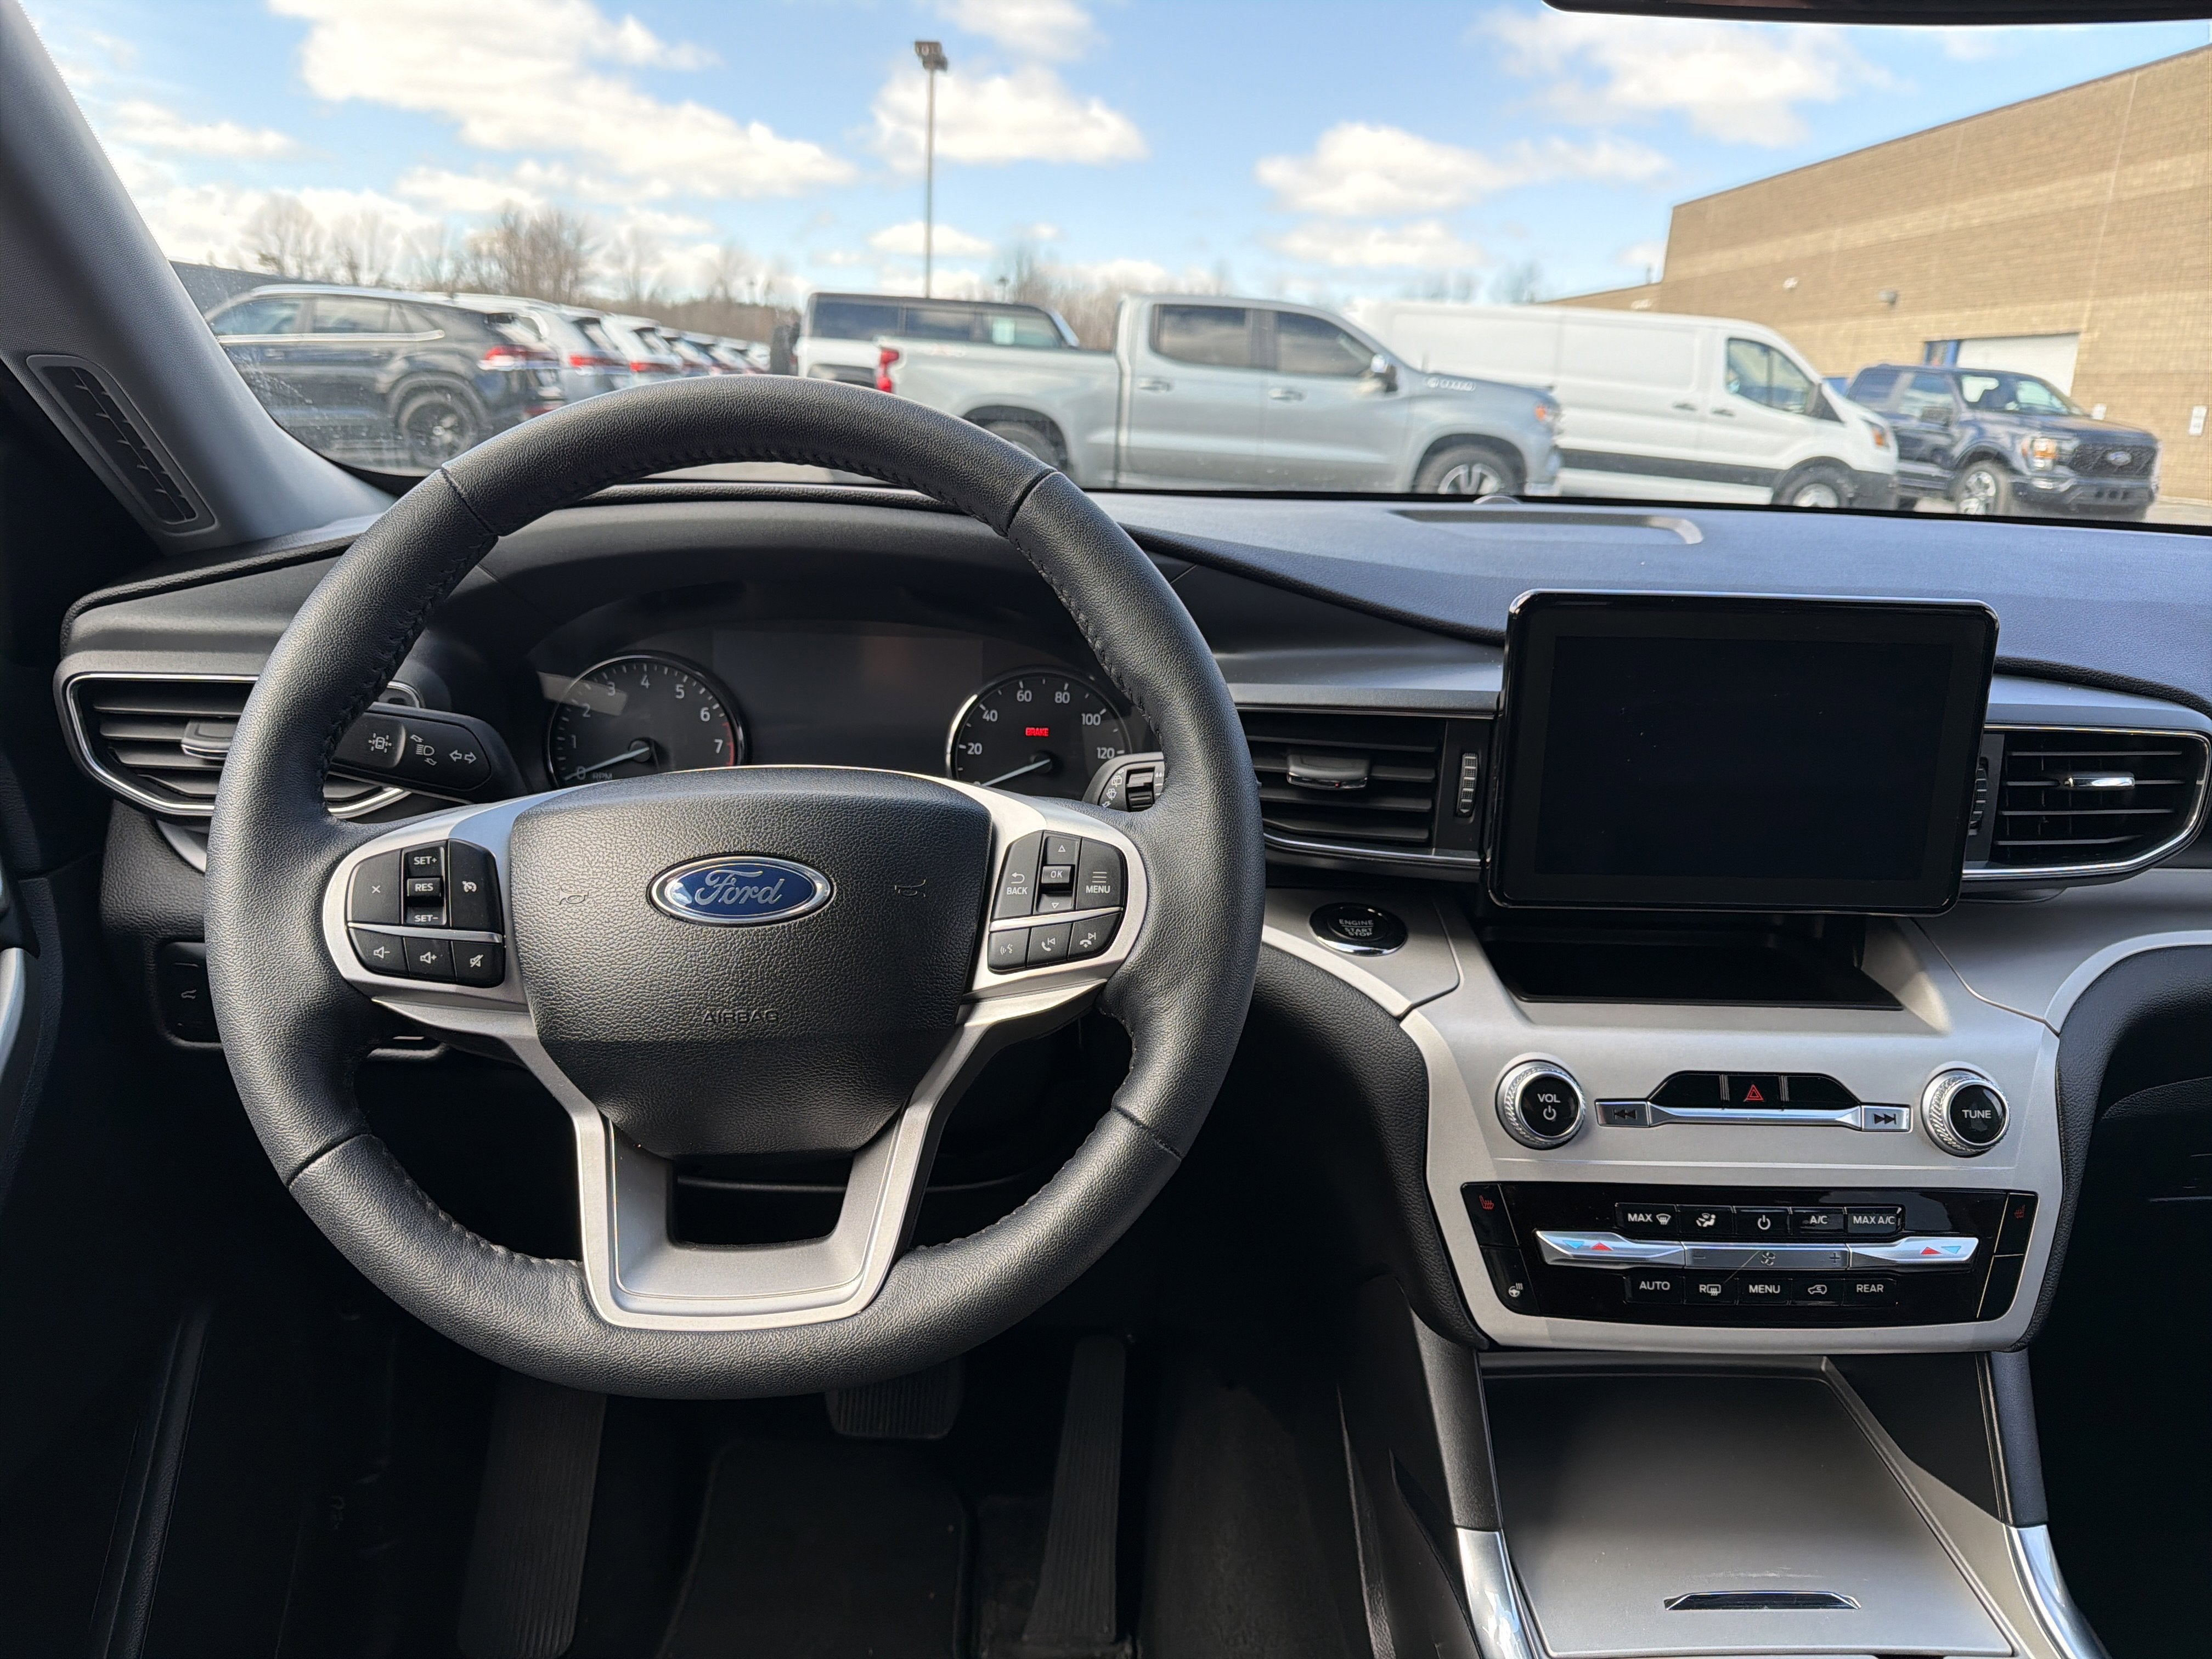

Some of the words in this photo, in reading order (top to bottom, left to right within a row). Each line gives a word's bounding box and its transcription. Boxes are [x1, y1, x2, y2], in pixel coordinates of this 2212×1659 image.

[640, 675, 651, 689] 4
[607, 682, 616, 697] 3
[675, 684, 685, 699] 5
[1017, 690, 1032, 703] 60
[1055, 691, 1070, 704] 80
[582, 704, 591, 718] 2
[700, 707, 710, 722] 6
[983, 709, 998, 722] 40
[1082, 713, 1101, 726] 100
[1025, 727, 1049, 737] BRAKE
[570, 735, 577, 748] 1
[714, 739, 723, 753] 7
[968, 742, 983, 755] 20
[1097, 747, 1115, 759] 120
[592, 772, 612, 781] RPM
[414, 856, 437, 865] SET+
[415, 883, 433, 892] RES
[695, 870, 785, 906] Ford
[1006, 887, 1028, 895] BACK
[1086, 885, 1110, 894] MENU
[703, 1010, 779, 1024] AIRBAG
[1537, 1093, 1560, 1103] VOL
[1962, 1109, 1991, 1119] TUNE
[1628, 1213, 1653, 1222] MAX
[1810, 1215, 1828, 1224] A/C
[1853, 1215, 1876, 1224] MAX
[1877, 1215, 1895, 1226] A/C
[1639, 1281, 1670, 1291] AUTO
[1749, 1284, 1781, 1294] MENU
[1856, 1284, 1884, 1293] REAR
